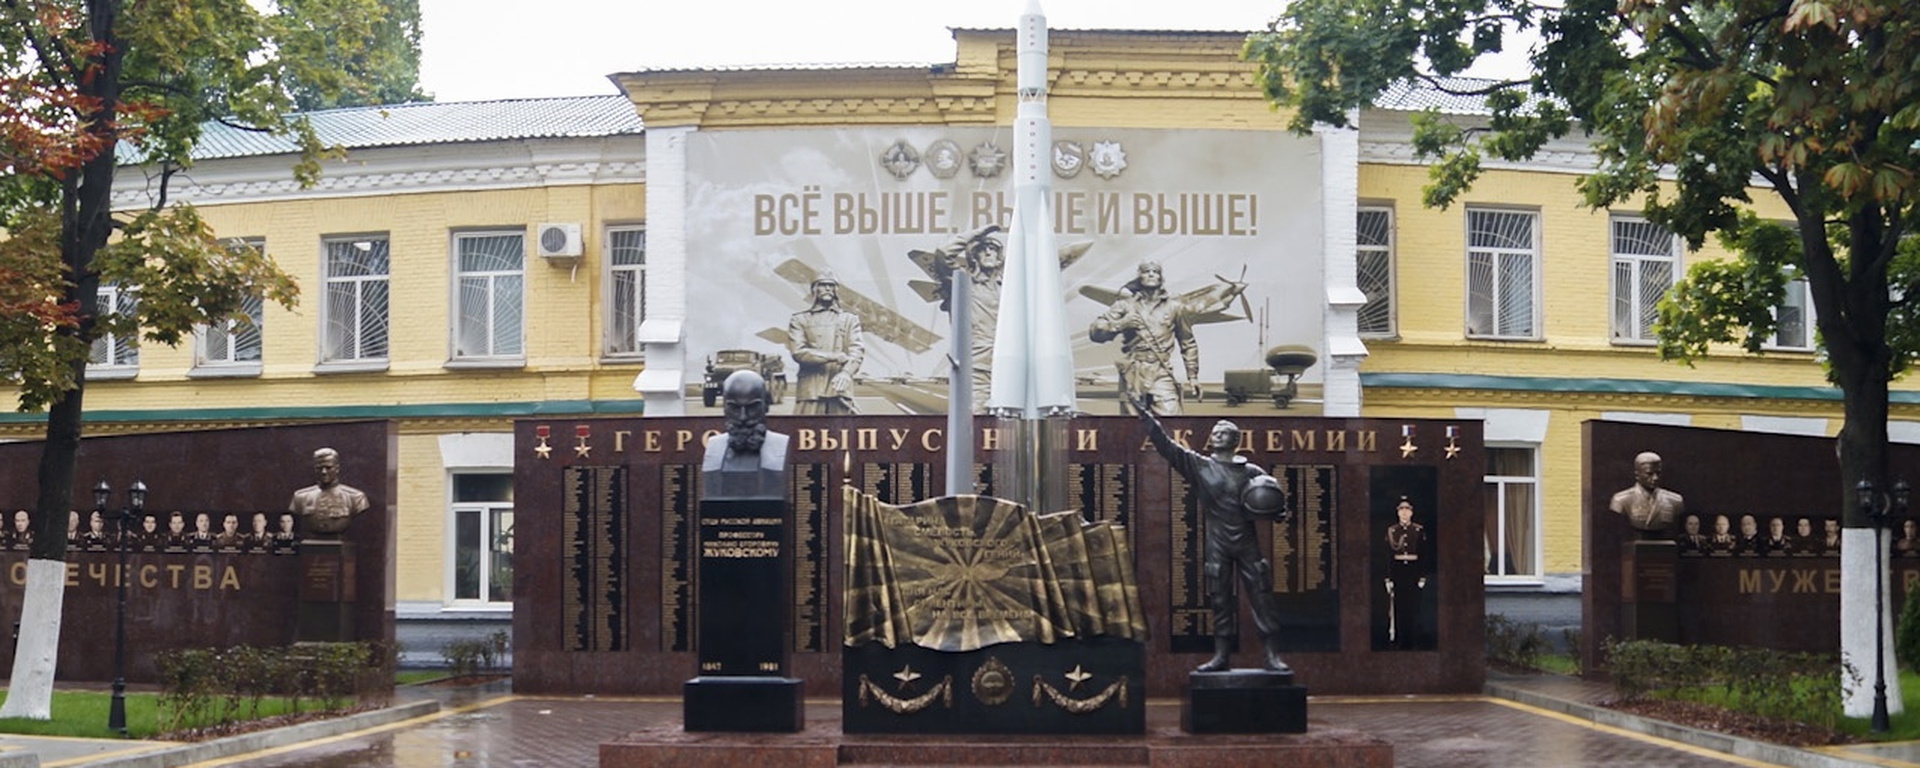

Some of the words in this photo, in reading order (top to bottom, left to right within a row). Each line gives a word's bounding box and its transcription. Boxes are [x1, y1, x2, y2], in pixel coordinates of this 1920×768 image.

[754, 185, 821, 236] ВСЁ
[972, 191, 1086, 234] ВЕ
[1098, 192, 1120, 234] И
[1133, 193, 1258, 236] ВЫШЕ!
[614, 429, 752, 452] ГЕРО
[798, 428, 1098, 452] ВЫПУСНИ
[703, 547, 780, 558] ЖУКОВСКОМУ
[10, 562, 241, 591] ОЕЧЕСТВА
[1739, 569, 1919, 594] МУЖЕВ
